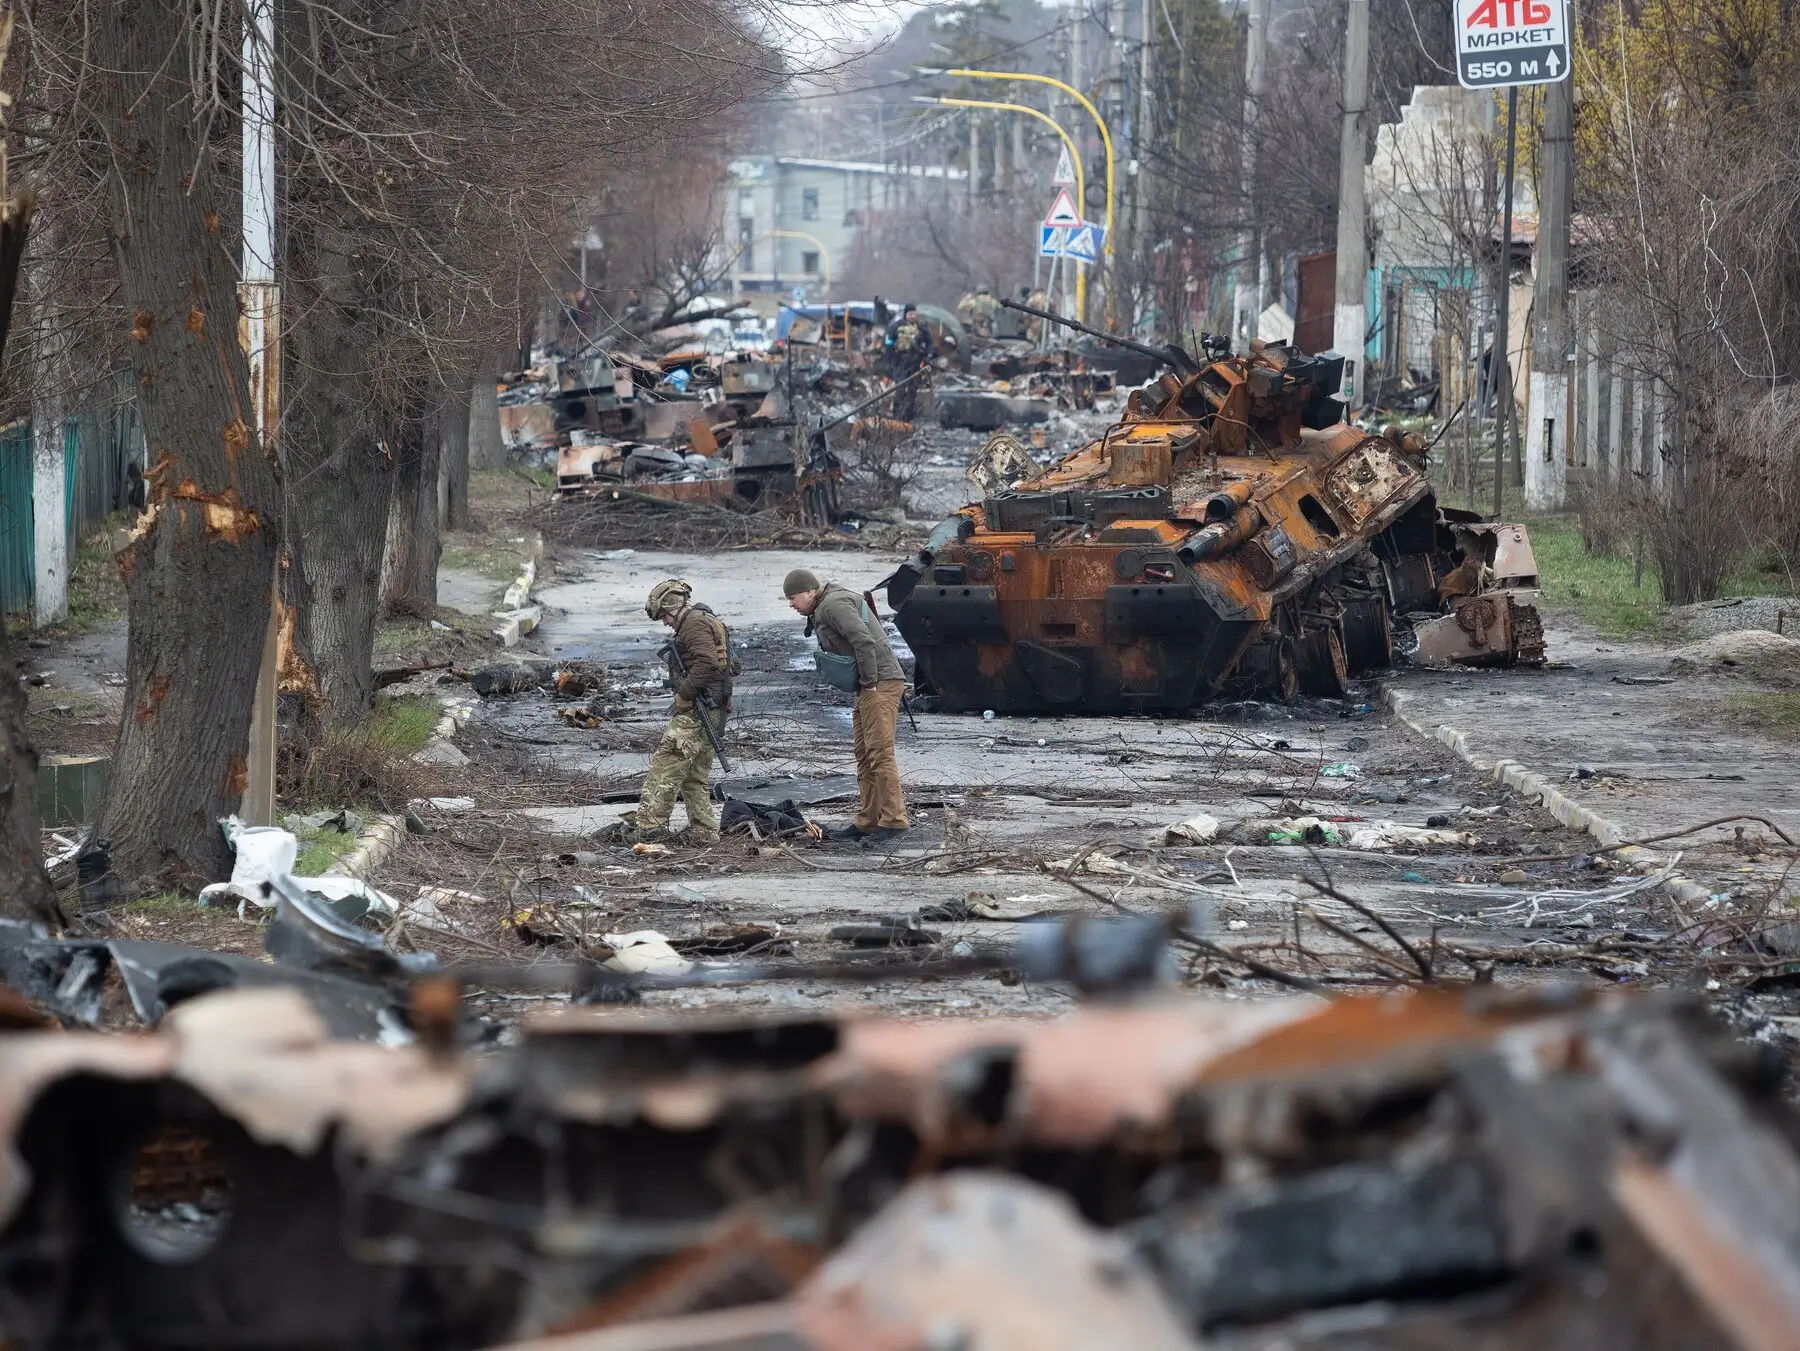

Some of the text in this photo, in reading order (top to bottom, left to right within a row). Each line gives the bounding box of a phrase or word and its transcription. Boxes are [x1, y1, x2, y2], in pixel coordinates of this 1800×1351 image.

[1467, 0, 1551, 28] АТБ
[1467, 28, 1555, 48] МАРКЕТ
[1467, 60, 1538, 79] 550 М
